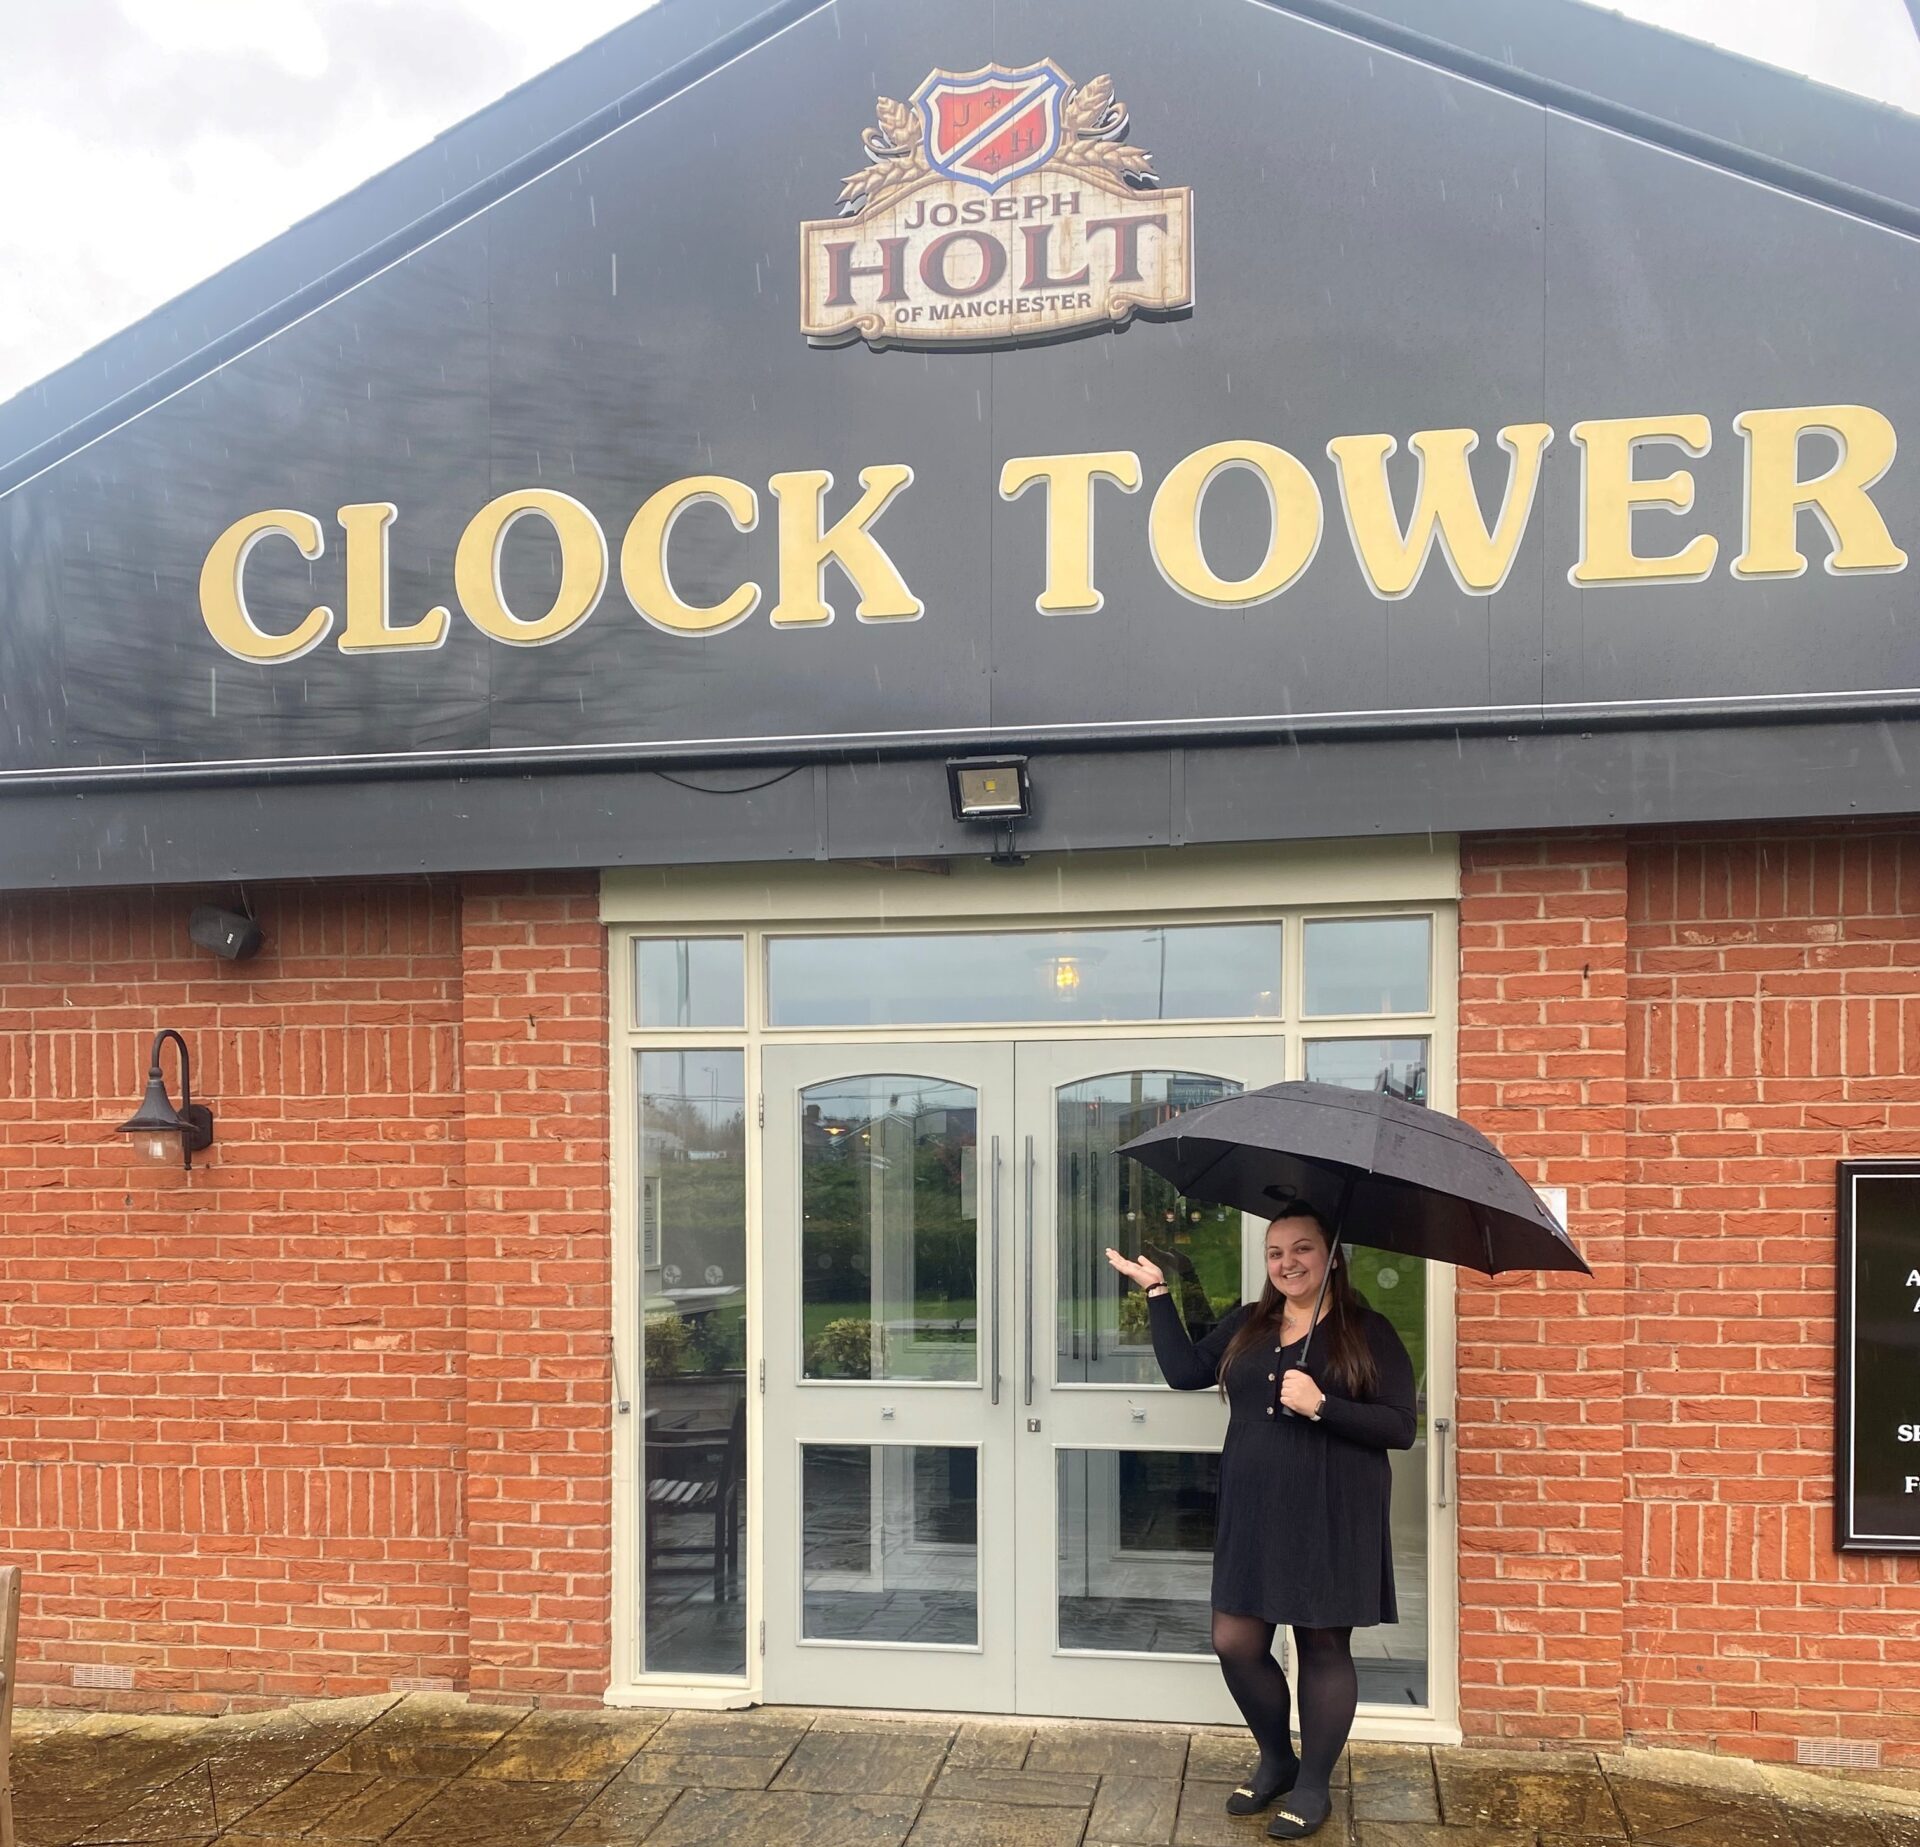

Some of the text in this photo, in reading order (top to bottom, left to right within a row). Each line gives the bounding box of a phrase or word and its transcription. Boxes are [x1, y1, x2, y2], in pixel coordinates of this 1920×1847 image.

[953, 103, 969, 127] J
[1011, 128, 1034, 152] H
[905, 192, 1081, 229] JOSEPH
[824, 214, 1168, 306] HOLT
[895, 293, 1092, 323] OF MANCHESTER
[199, 404, 1908, 665] CLOCK TOWER
